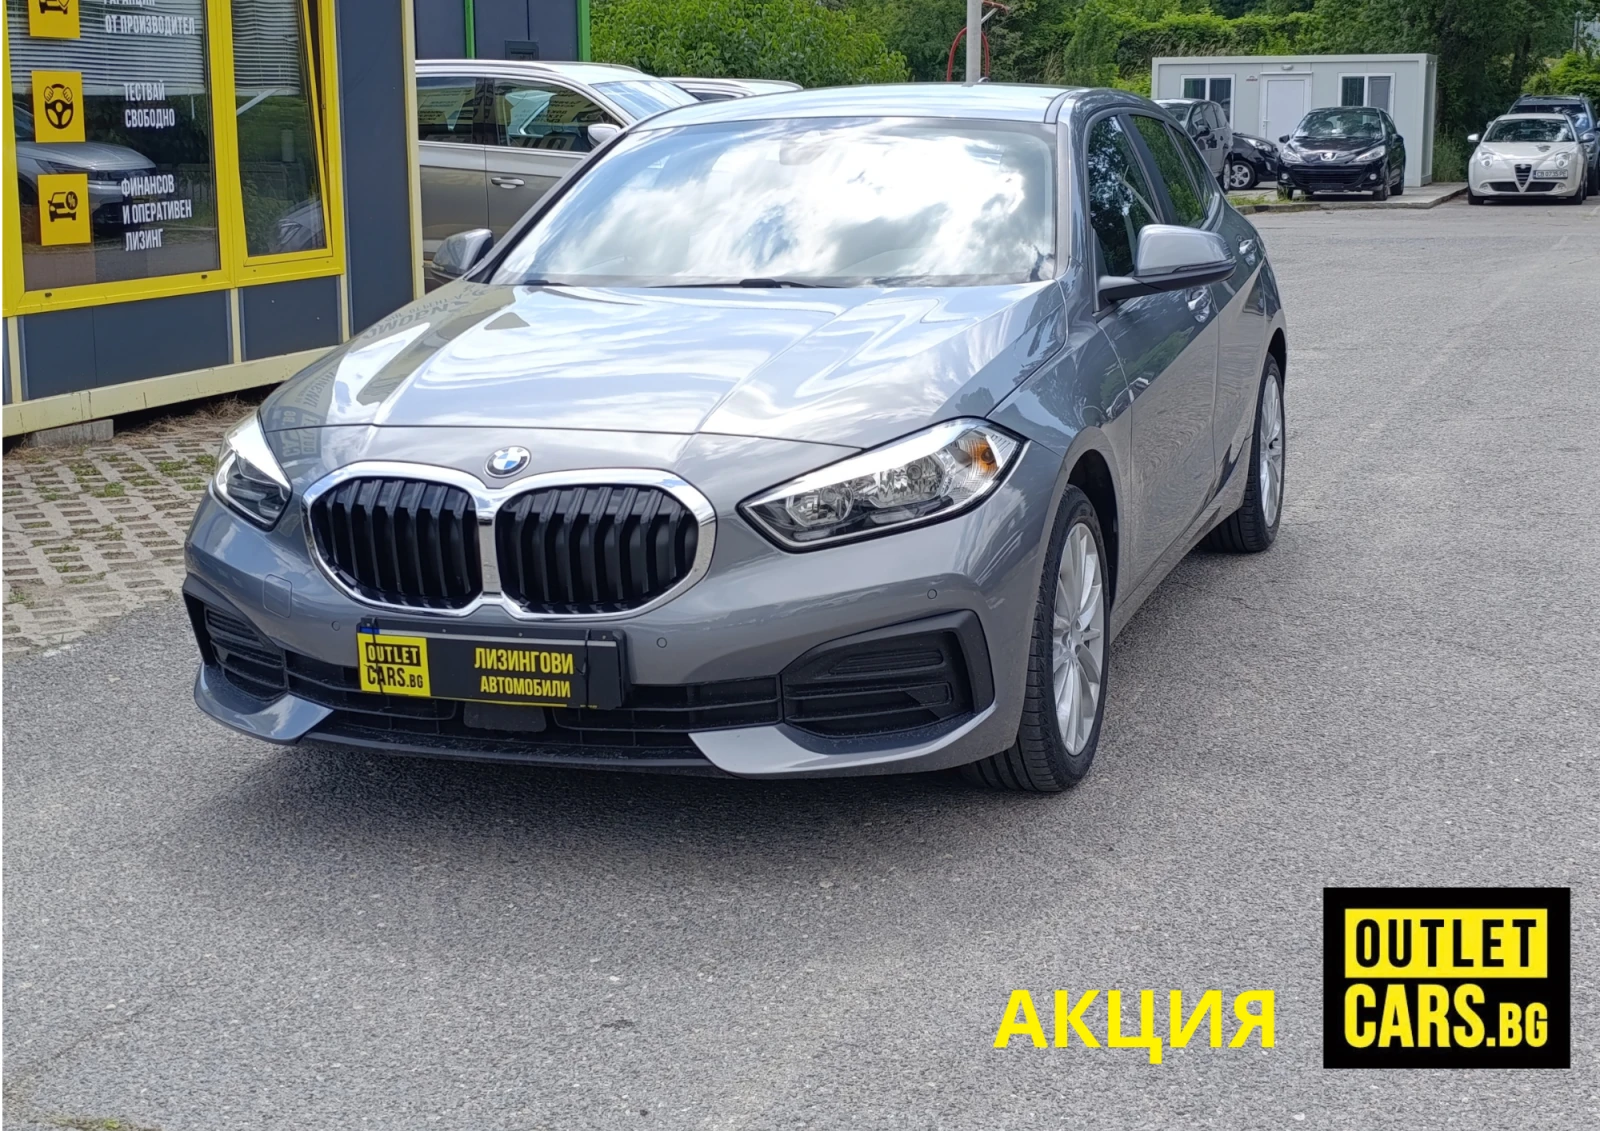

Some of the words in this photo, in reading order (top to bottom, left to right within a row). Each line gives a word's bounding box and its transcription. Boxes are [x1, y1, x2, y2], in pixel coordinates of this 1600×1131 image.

[105, 15, 118, 34] ОТ
[120, 15, 196, 36] ПРОИЗВОДИТЕЛ
[124, 80, 166, 101] ТЕСТВАЙ
[125, 108, 176, 129] СВОБОДНО
[121, 174, 175, 197] ФИНАНСОВ
[122, 204, 131, 225] И
[131, 199, 193, 224] ОПЕРАТИВЕН
[125, 228, 164, 252] ЛИЗИНГ
[367, 645, 418, 664] OUTLET
[474, 647, 574, 675] ЛИЗИНГОВИ
[367, 665, 424, 689] CARS.BG
[480, 675, 571, 698] АВТОМОБИЛИ
